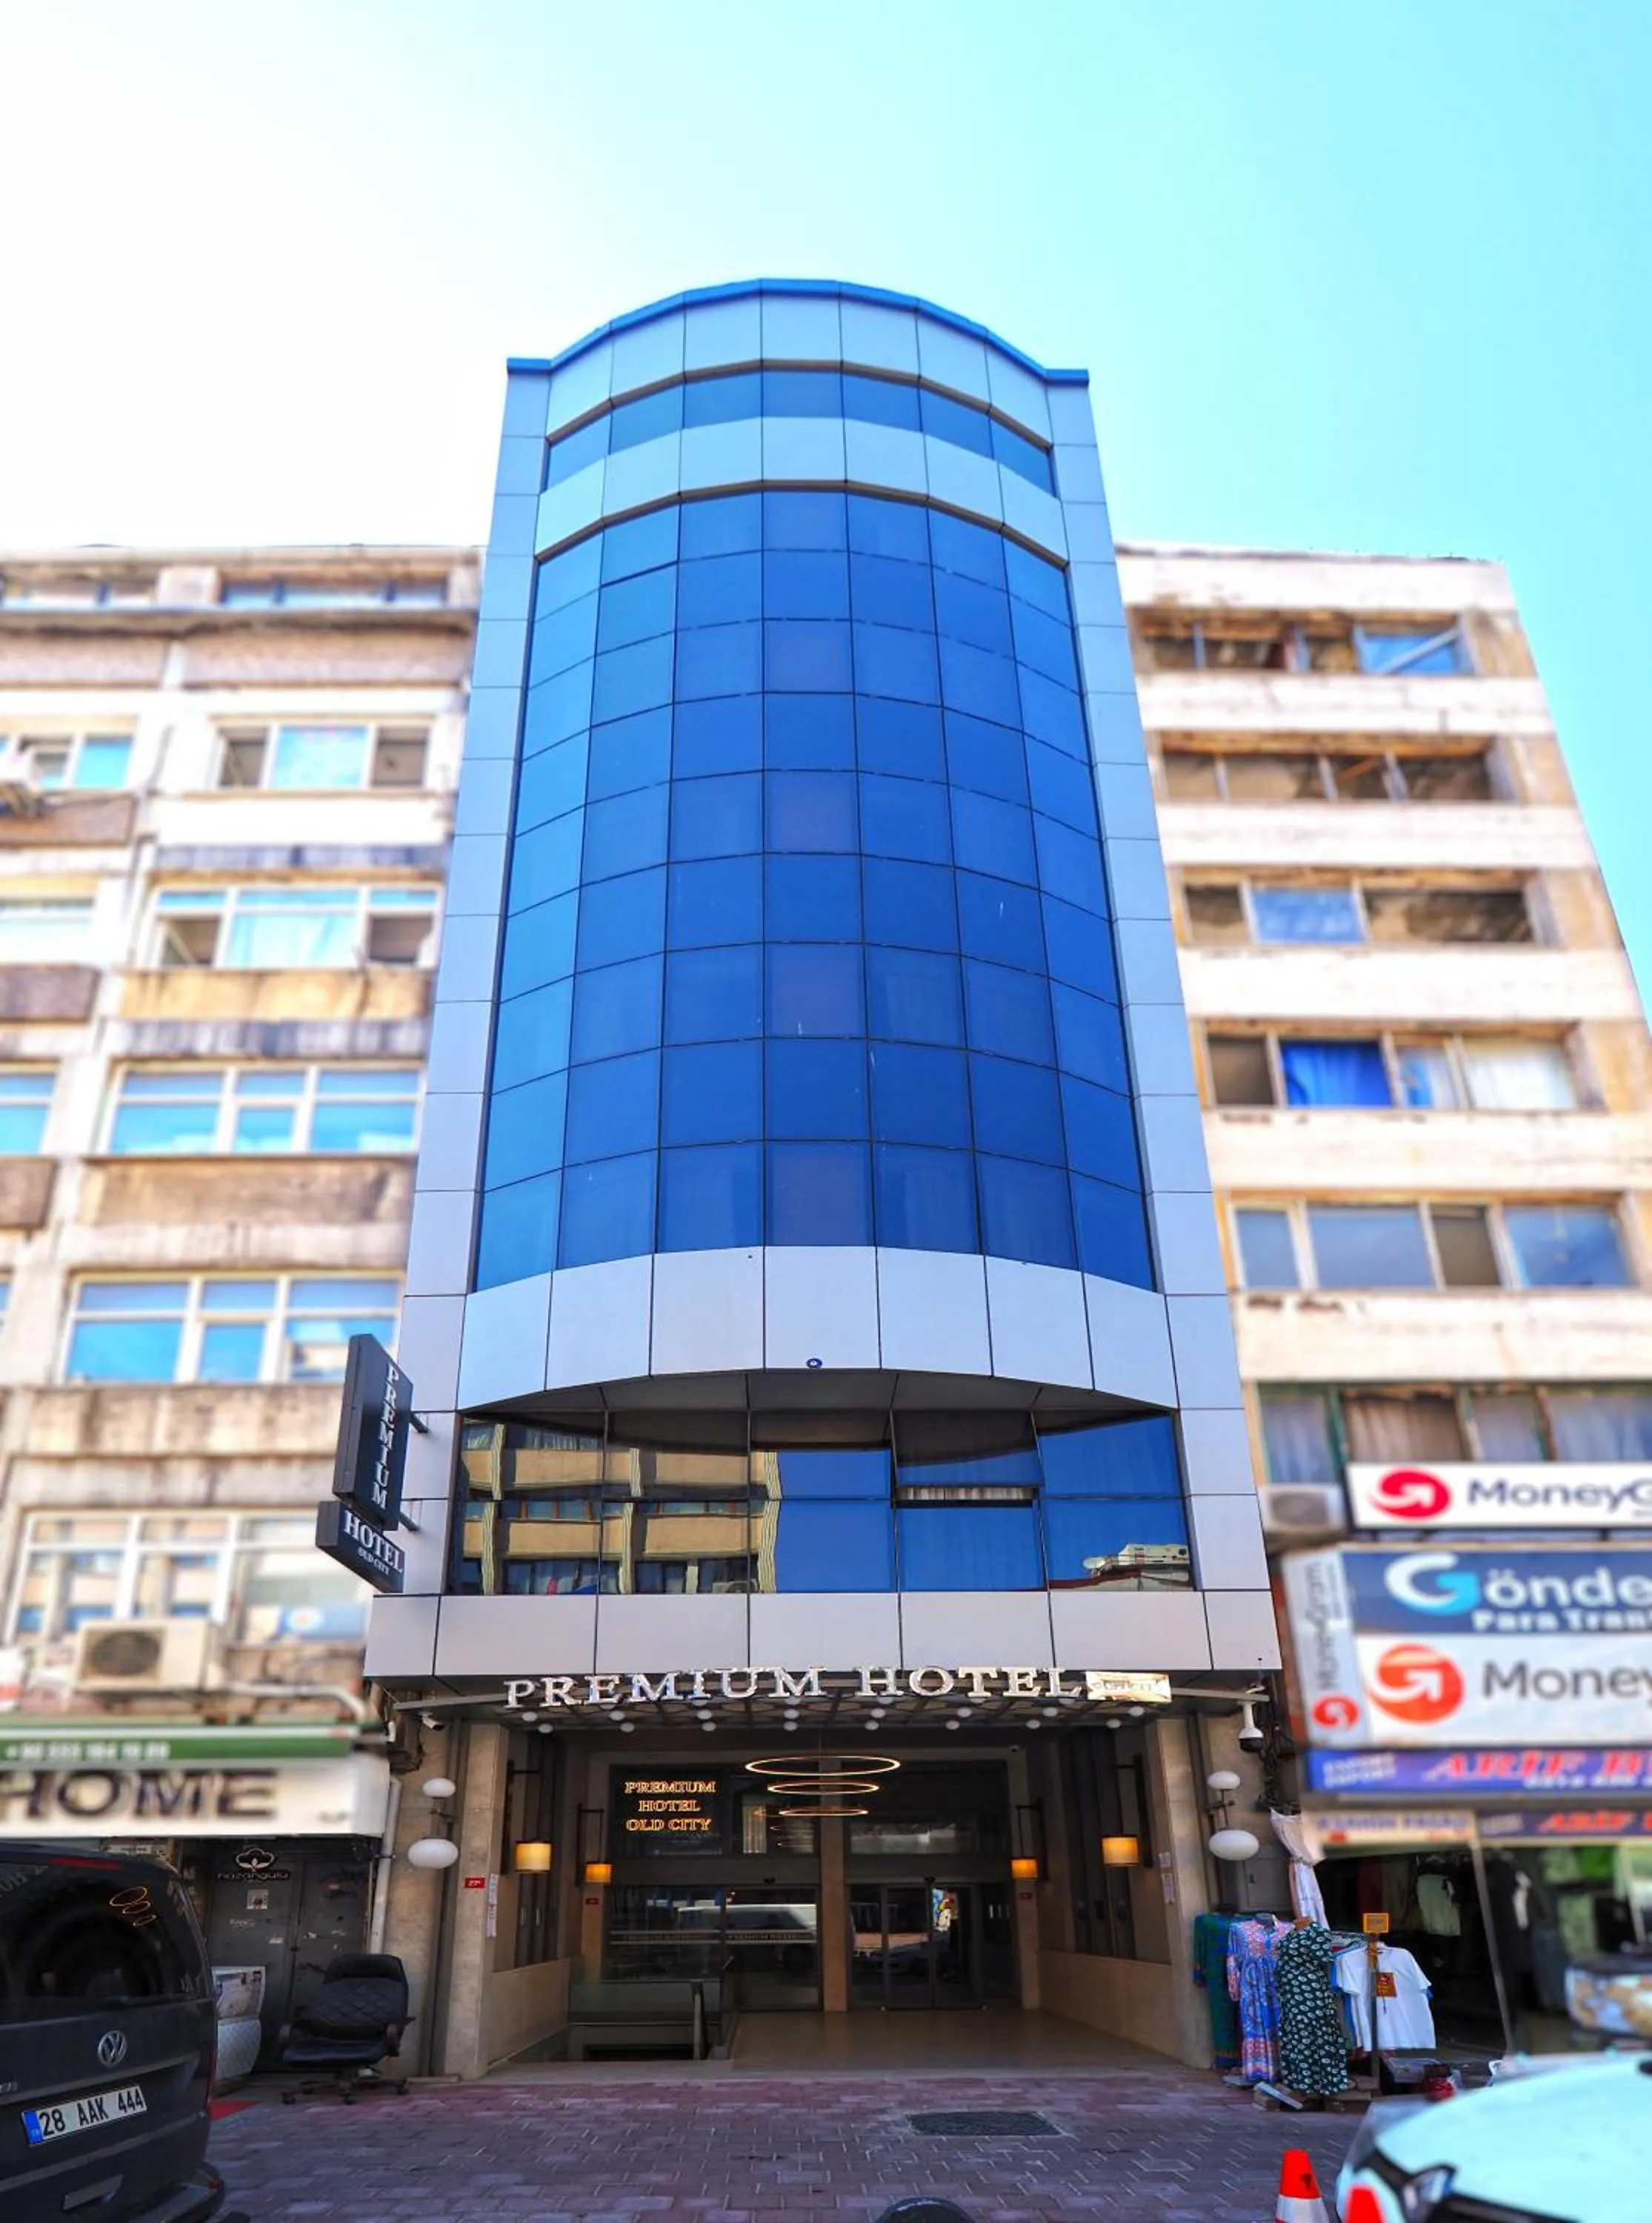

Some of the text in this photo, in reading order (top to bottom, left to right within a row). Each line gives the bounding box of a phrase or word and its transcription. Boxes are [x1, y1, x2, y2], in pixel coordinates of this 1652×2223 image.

[372, 1363, 399, 1509] PREMIUM
[343, 1509, 403, 1573] HOTEL
[503, 1665, 1083, 1709] PREMIUM HOTEL
[625, 1781, 716, 1793] PREMIUM
[638, 1800, 701, 1812] HOTEL
[626, 1818, 711, 1831] OLD CITY
[39, 2109, 65, 2136] 28
[76, 2096, 109, 2126] AAK
[118, 2088, 144, 2113] 444
